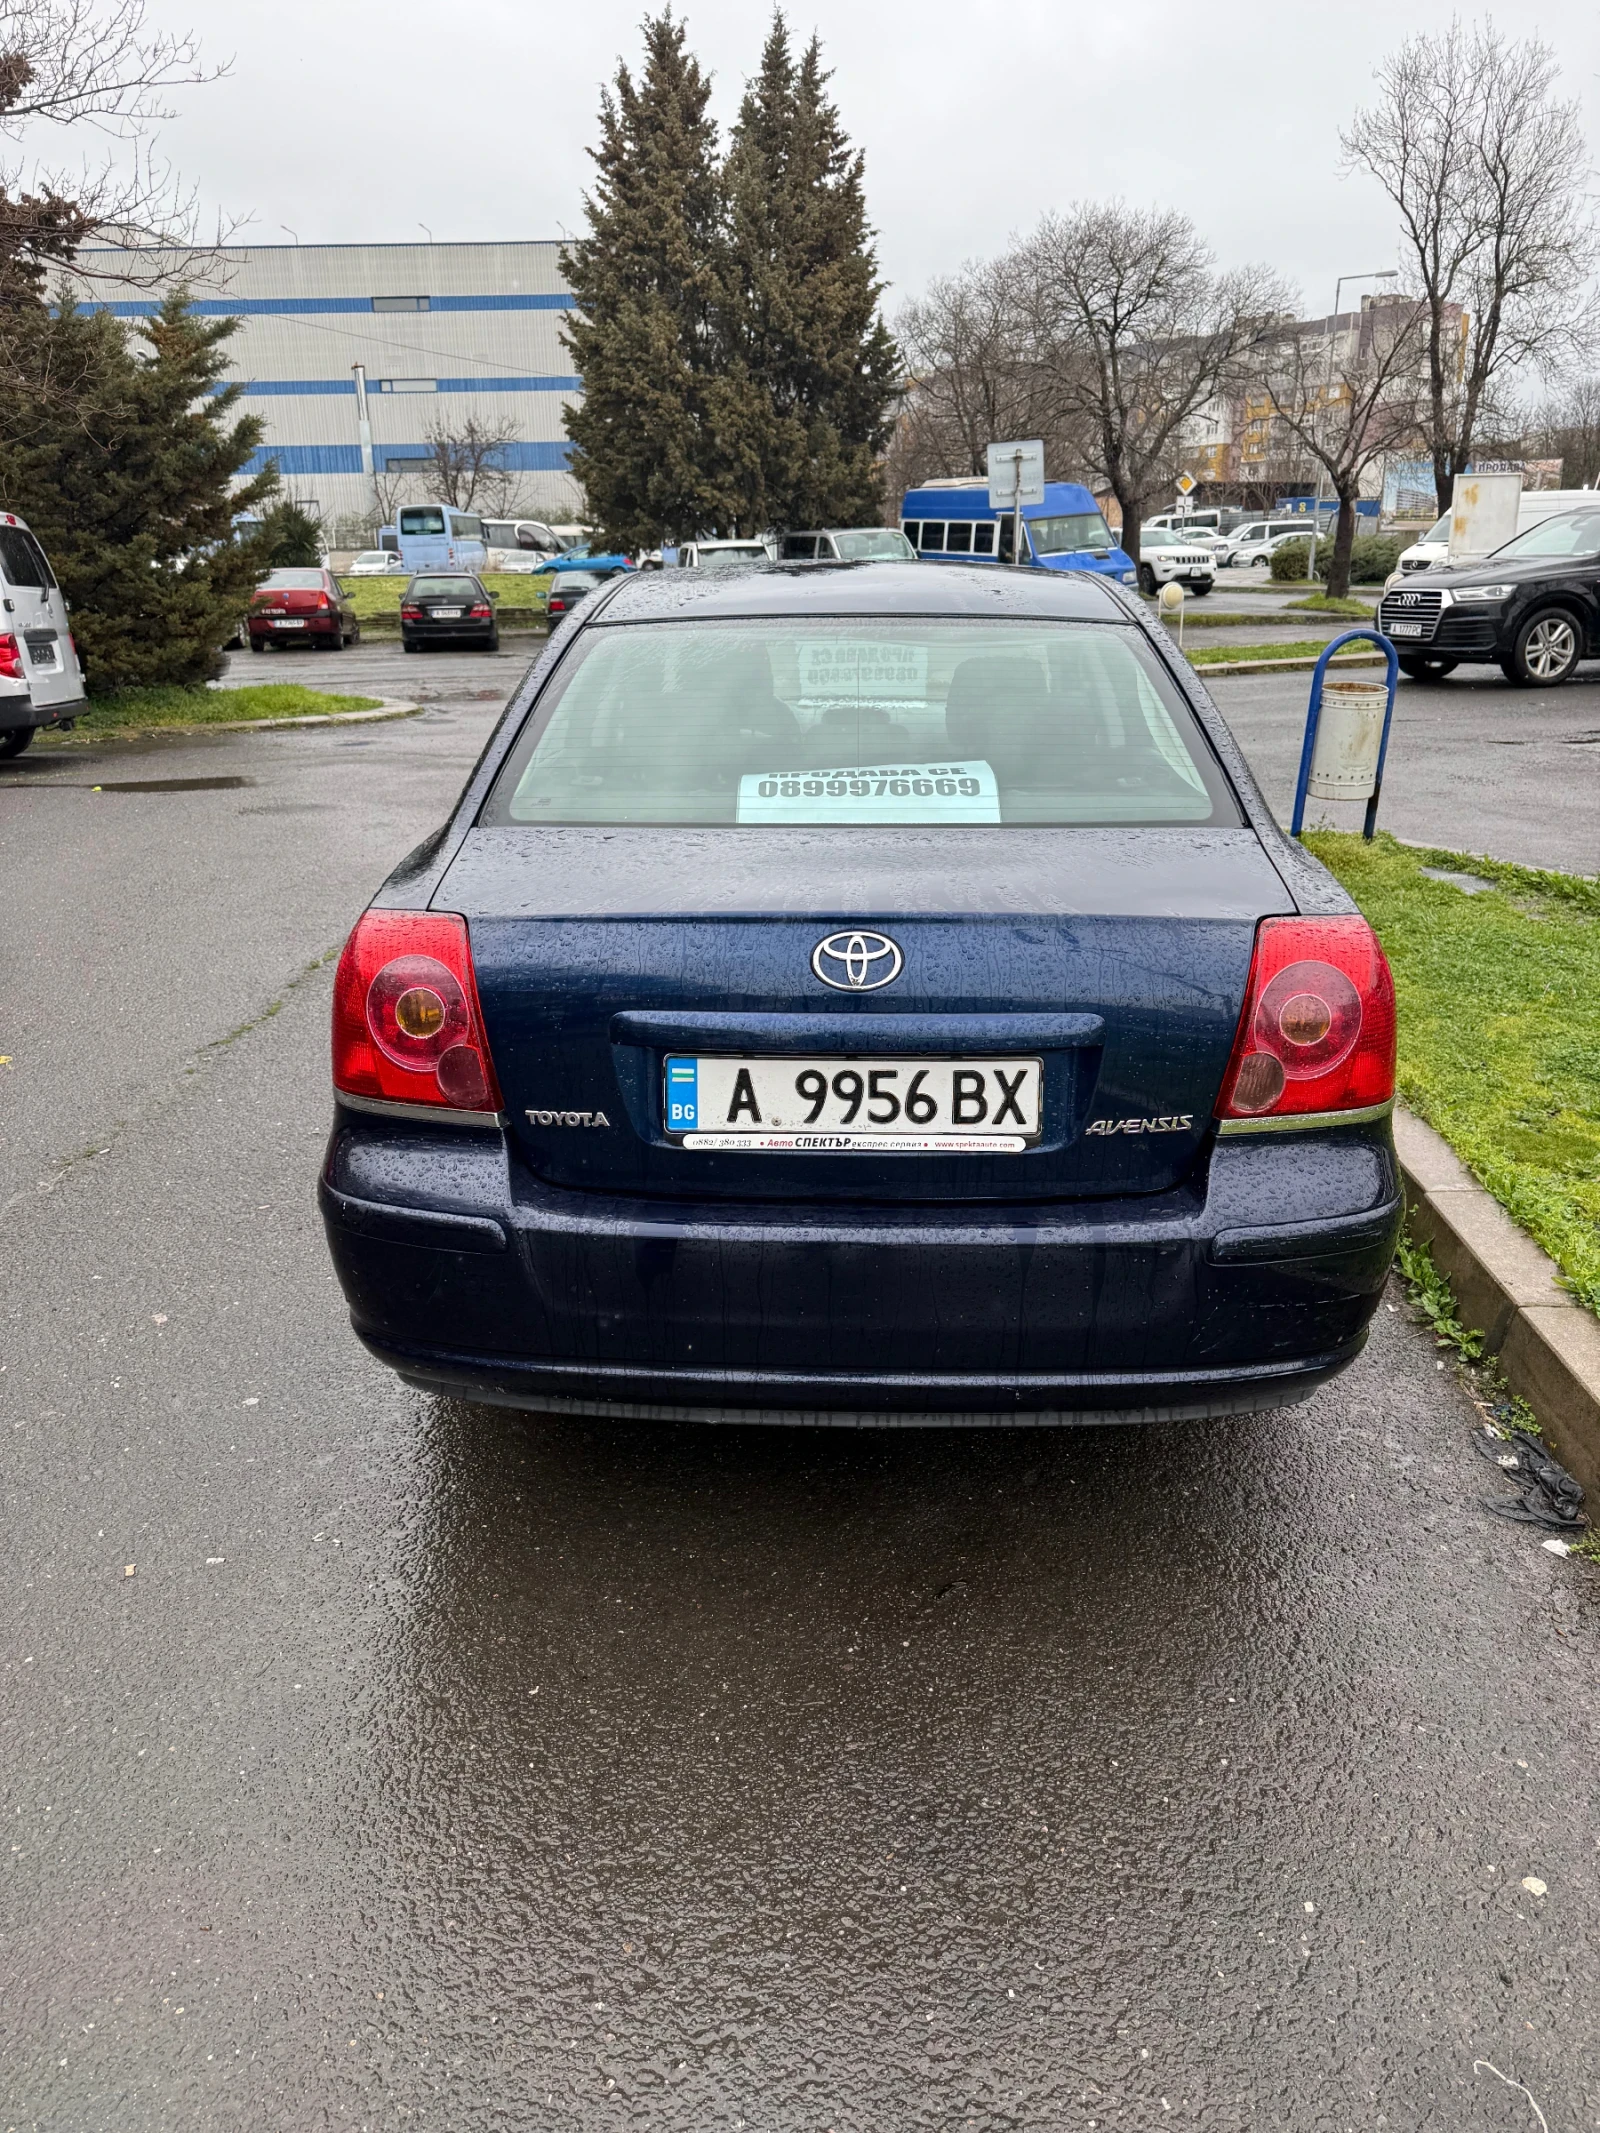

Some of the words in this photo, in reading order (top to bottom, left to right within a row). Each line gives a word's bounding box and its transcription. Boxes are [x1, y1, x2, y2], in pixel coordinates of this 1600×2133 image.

[758, 778, 981, 798] 0899976669
[726, 1067, 763, 1123] A
[524, 1109, 611, 1128] TOYOTA
[671, 1103, 695, 1121] BG
[1085, 1114, 1194, 1136] AVENSIS
[766, 1138, 794, 1148] Авто
[795, 1137, 852, 1148] СПЕКТЪР
